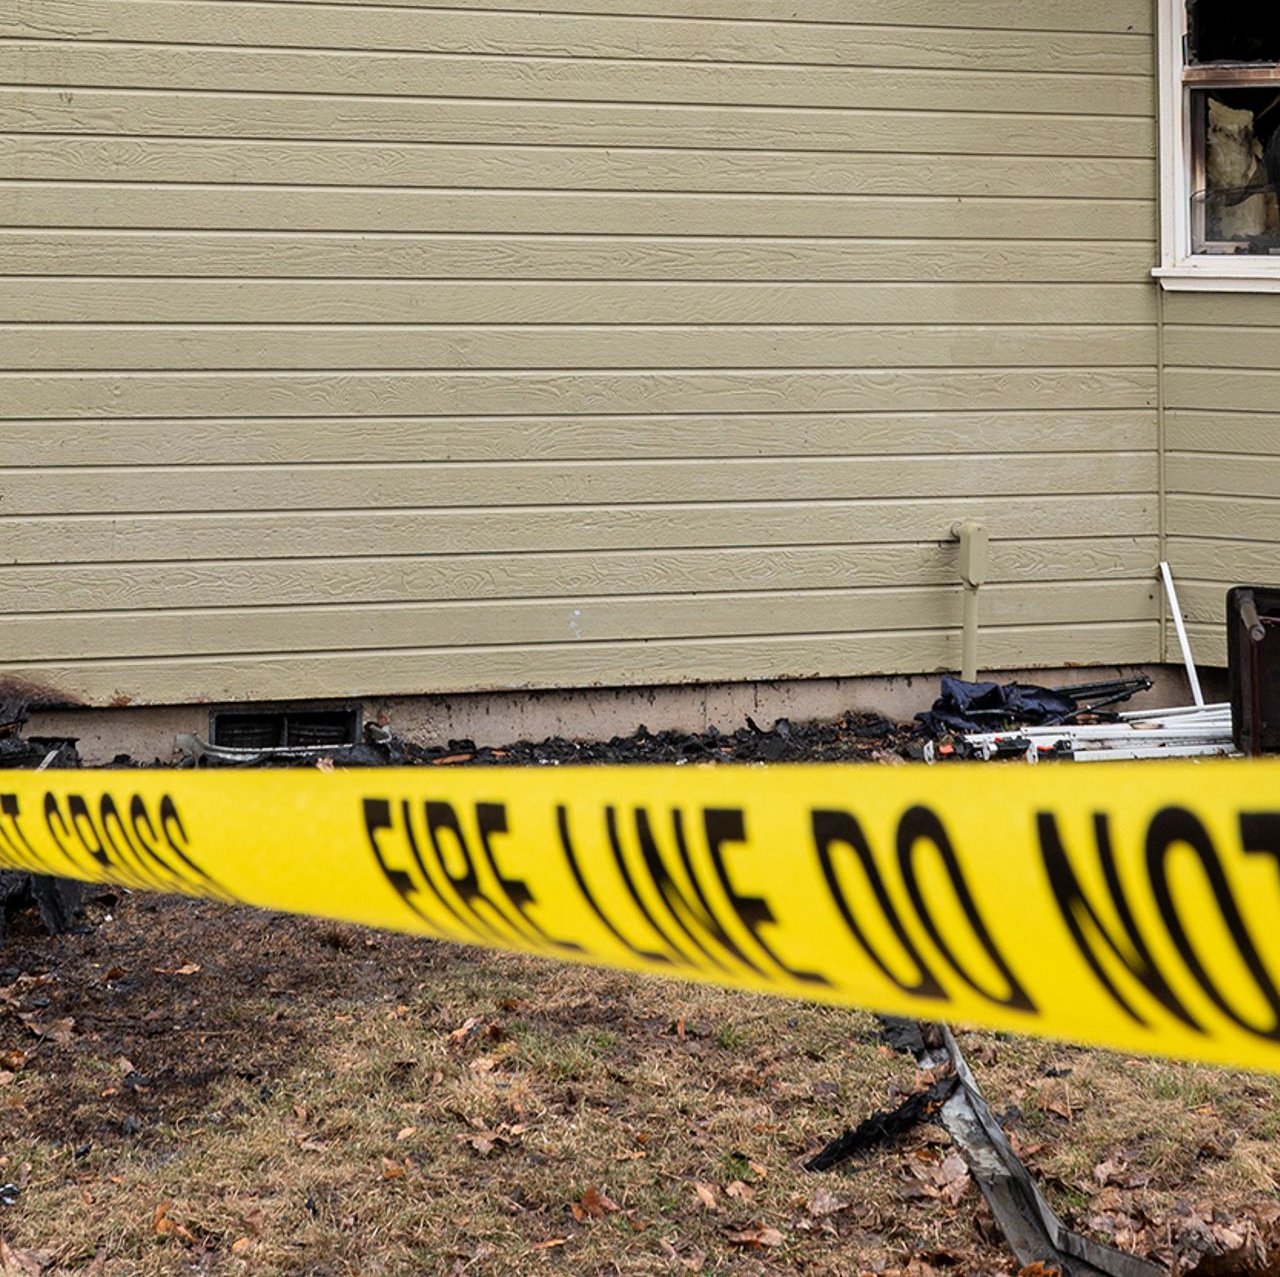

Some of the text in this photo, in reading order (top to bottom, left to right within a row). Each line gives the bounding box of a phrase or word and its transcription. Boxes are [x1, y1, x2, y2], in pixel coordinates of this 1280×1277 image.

[361, 797, 585, 952] FIRE
[556, 804, 834, 989] LINE
[811, 806, 1042, 1016] DO
